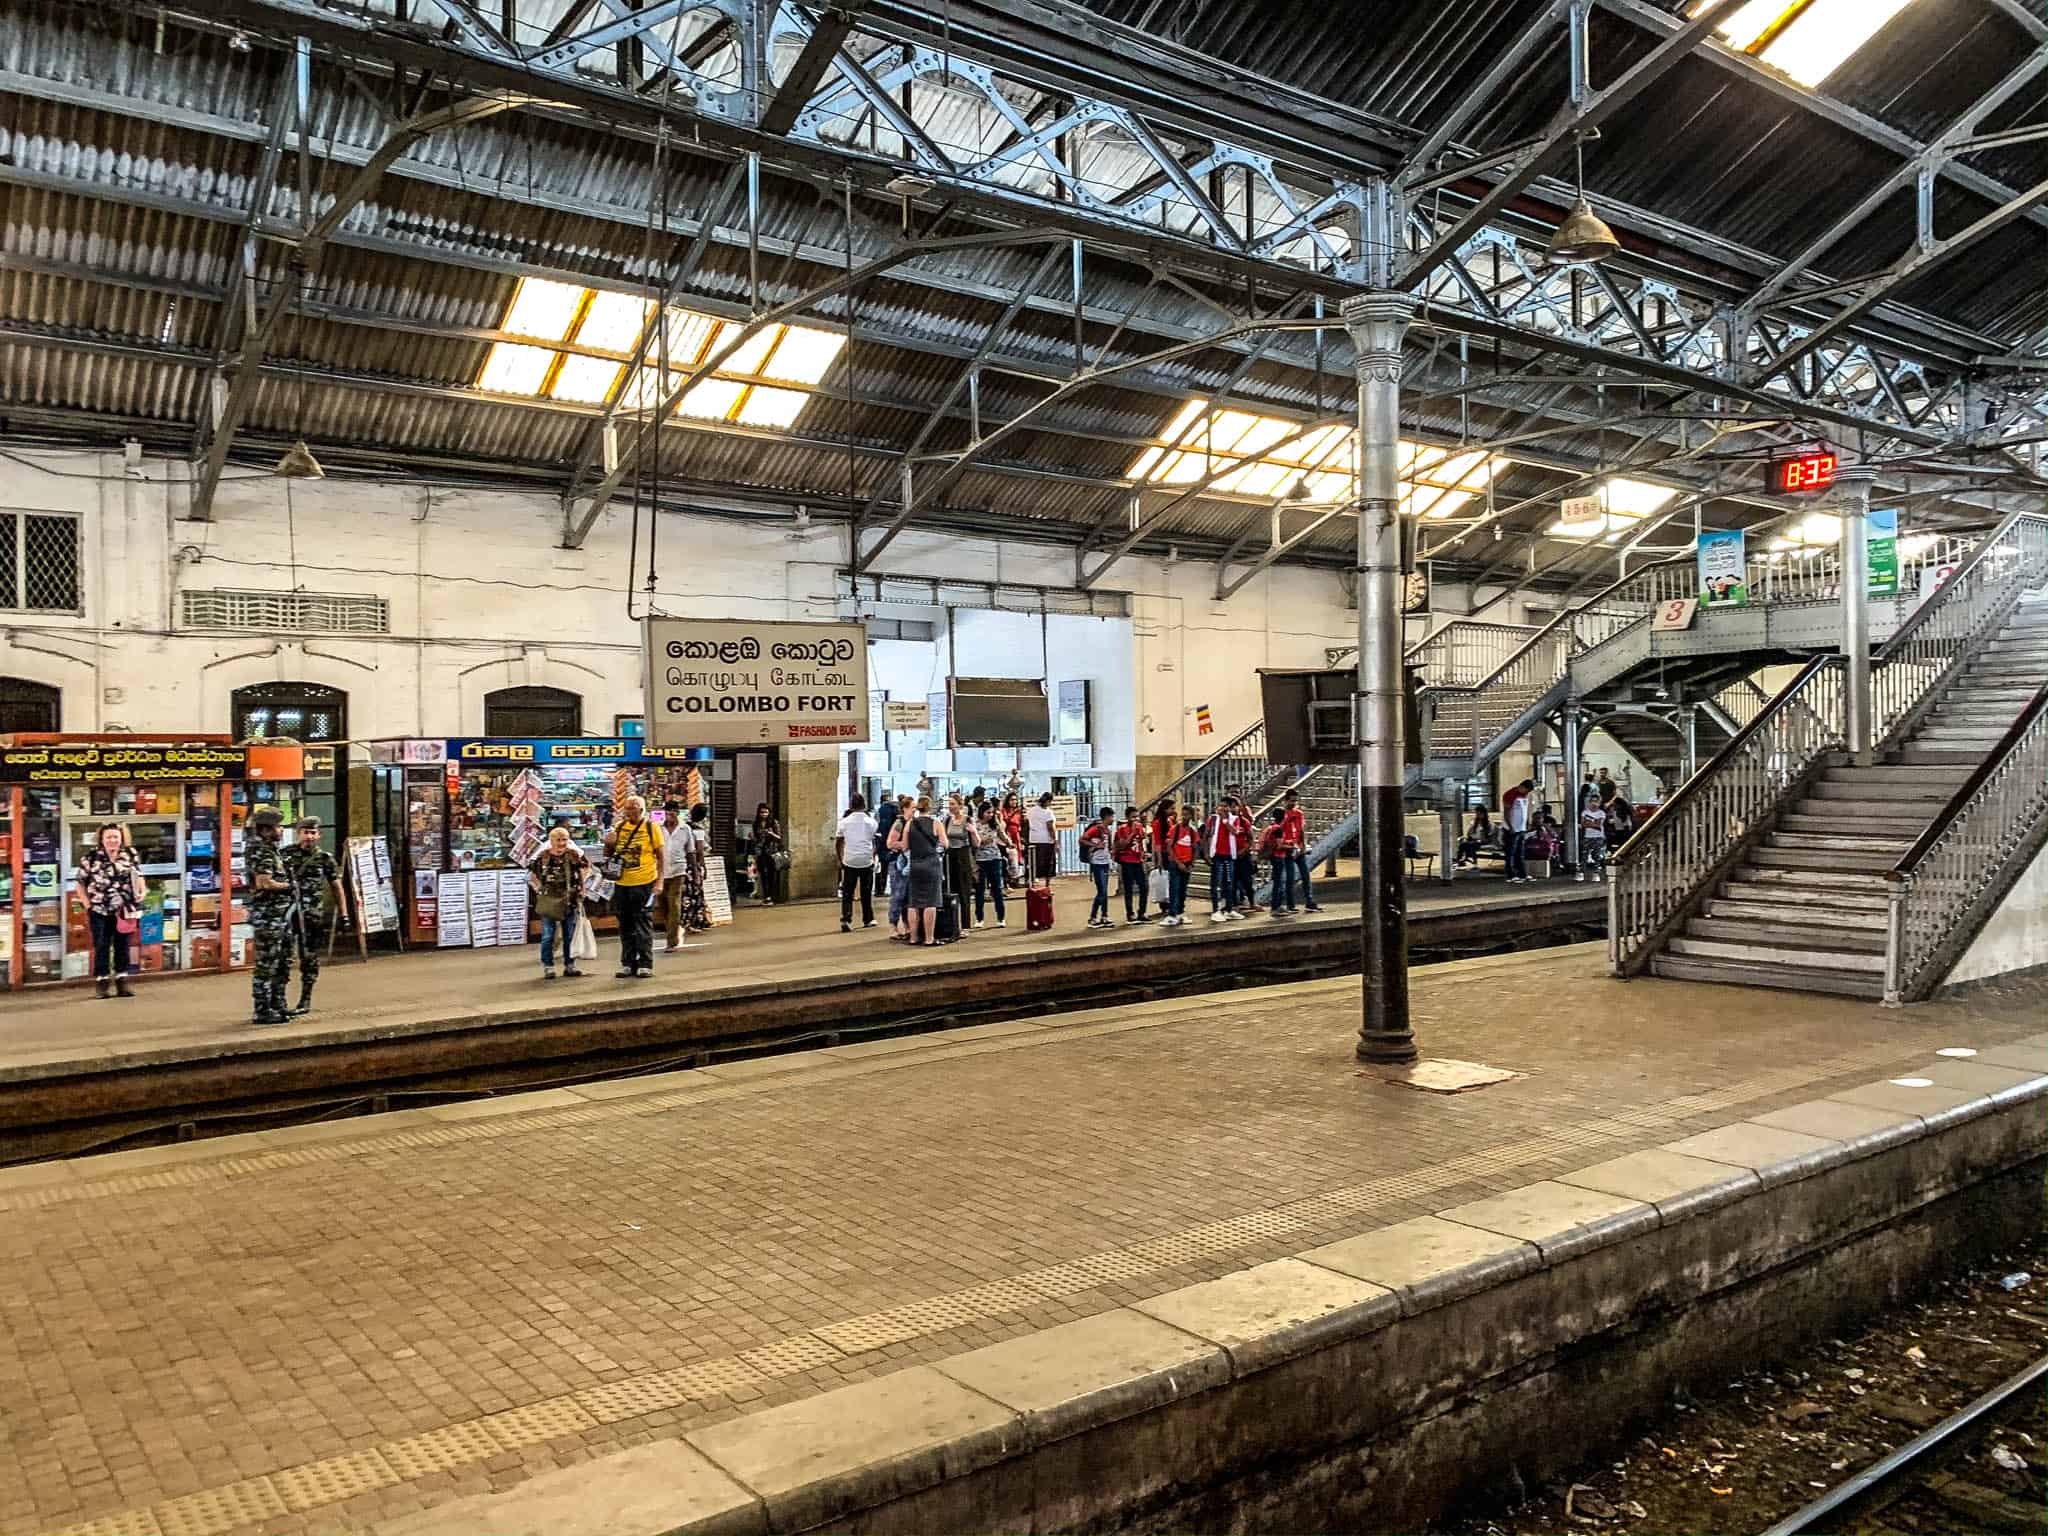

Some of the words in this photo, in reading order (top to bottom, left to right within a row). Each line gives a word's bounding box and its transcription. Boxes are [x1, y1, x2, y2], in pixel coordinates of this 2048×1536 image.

[1787, 457, 1833, 487] 8:32
[1665, 600, 1685, 622] 3
[665, 636, 761, 664] කොළඹ
[771, 639, 855, 666] කොටුව
[666, 696, 790, 713] COLOMBO
[798, 696, 856, 711] FORT
[800, 725, 837, 736] FASHION
[840, 724, 857, 736] BUG
